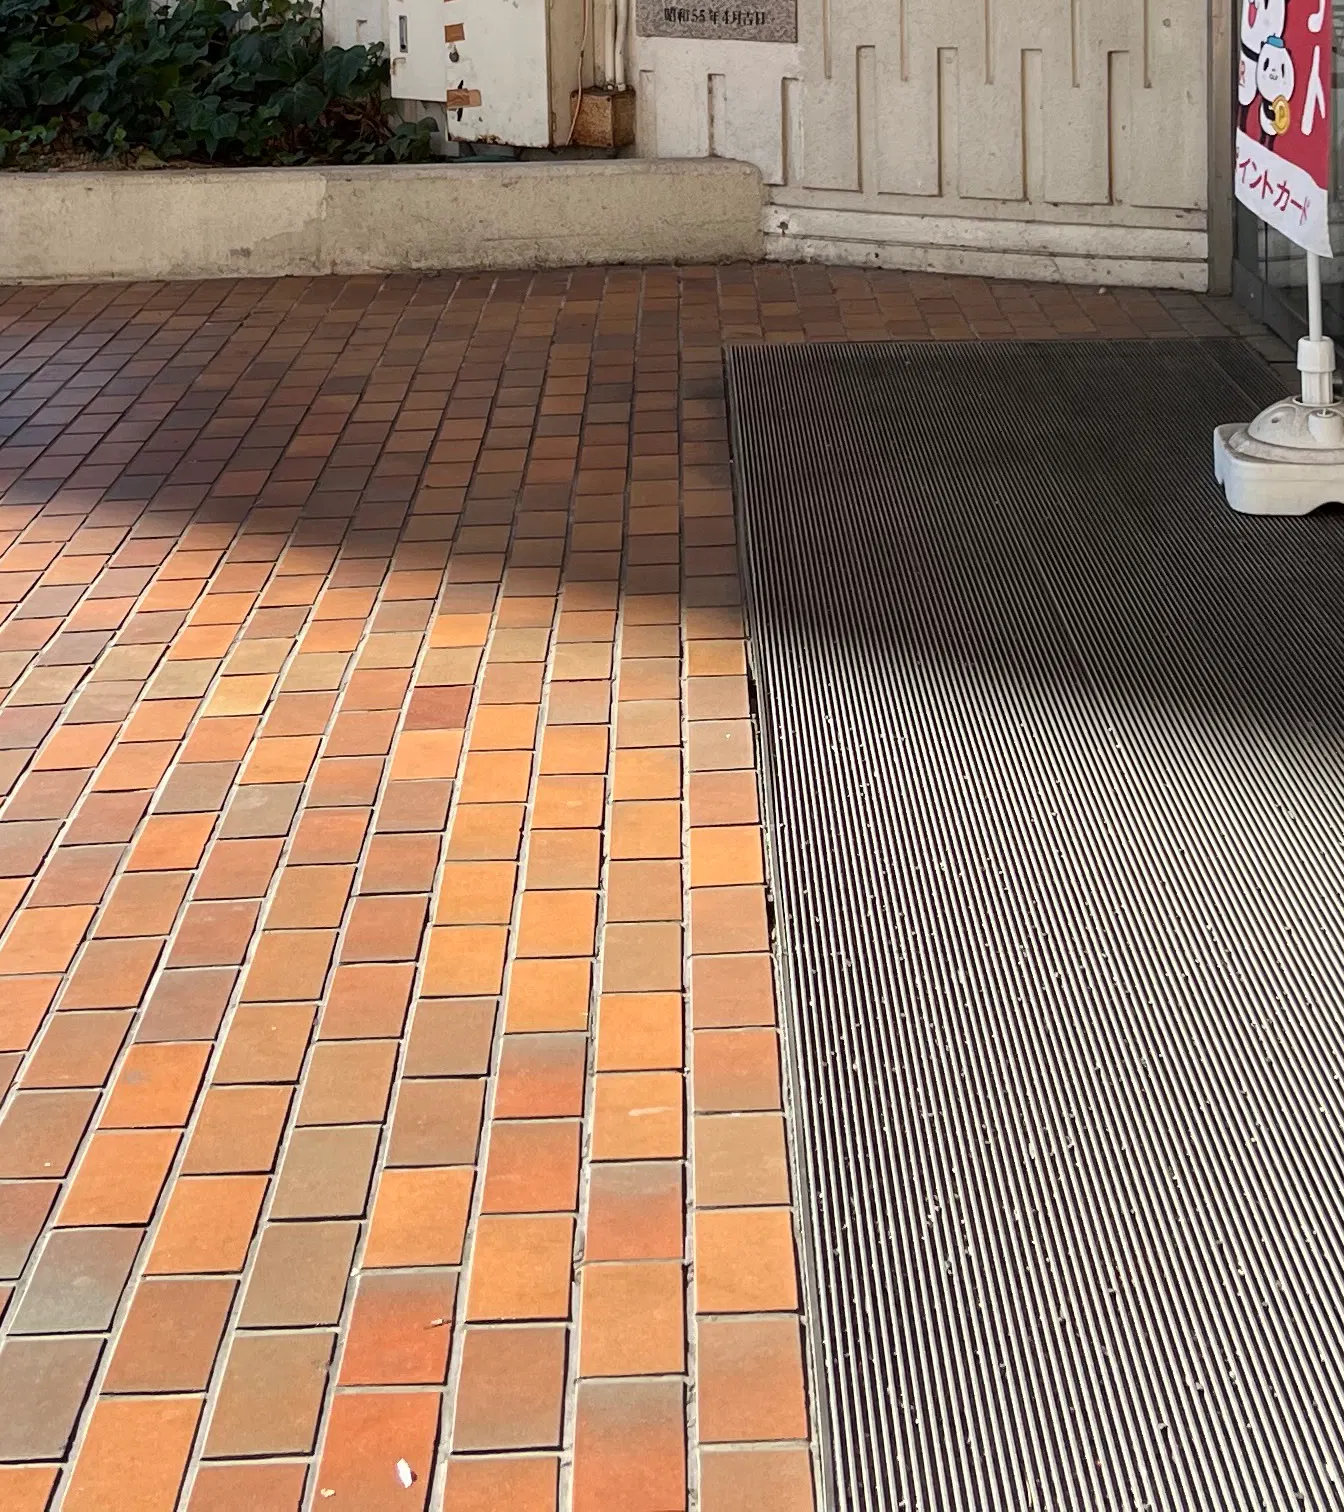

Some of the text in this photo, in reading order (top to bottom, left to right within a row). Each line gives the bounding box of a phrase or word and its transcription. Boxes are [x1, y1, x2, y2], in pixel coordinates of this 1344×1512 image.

[1235, 146, 1312, 226] イントカード
